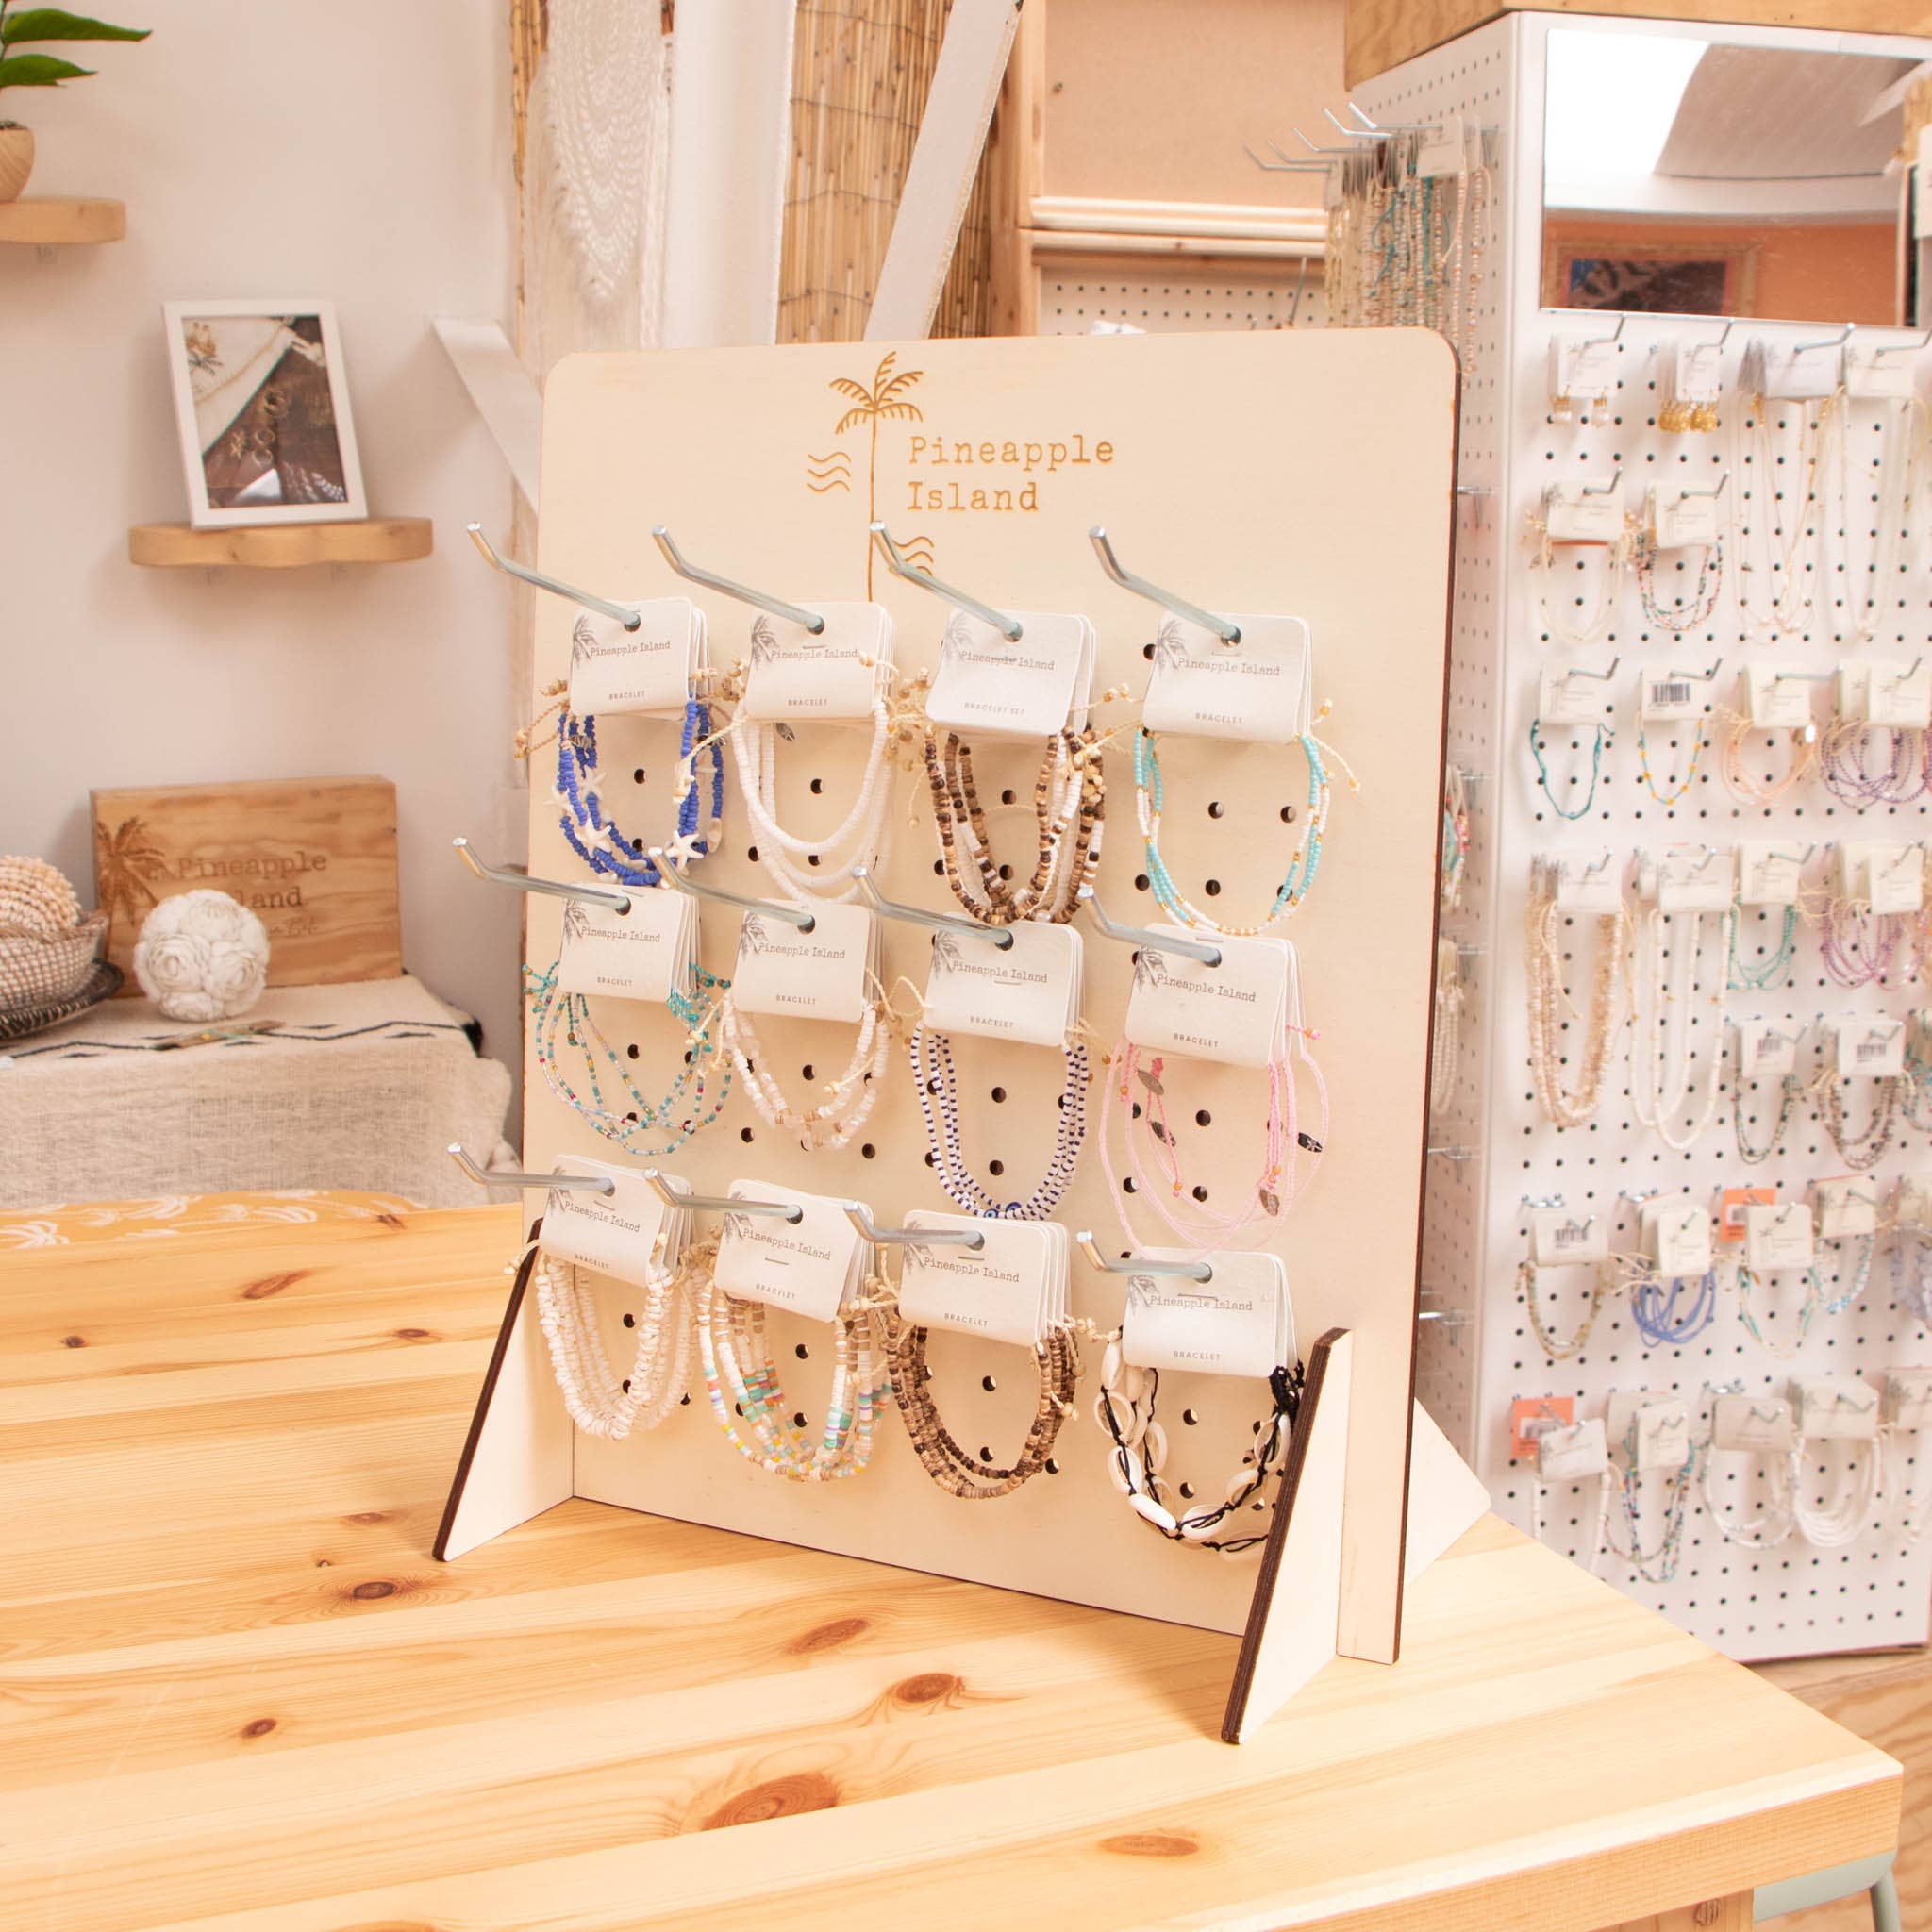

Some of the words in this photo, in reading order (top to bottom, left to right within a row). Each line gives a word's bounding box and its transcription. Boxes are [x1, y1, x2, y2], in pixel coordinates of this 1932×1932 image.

[909, 434, 1114, 471] Pineapple
[908, 482, 1039, 510] Island
[591, 643, 637, 657] Pineapple
[640, 641, 671, 652] Island
[770, 649, 822, 659] Pineapple
[824, 649, 858, 658] Island
[1018, 657, 1055, 671] Island
[1177, 658, 1238, 673] Pineapple
[1241, 664, 1281, 676] Island
[608, 691, 645, 700] BRACELET
[788, 698, 827, 707] BRACELET
[964, 703, 1008, 714] BRACELET
[1195, 713, 1243, 724] BRACELET
[177, 851, 327, 880] Pineapple
[234, 886, 303, 908] land
[581, 926, 628, 941] Pineapple
[629, 929, 660, 942] Island
[758, 942, 809, 957] Pineapple
[811, 948, 846, 959] Island
[952, 960, 1009, 979] Pineapple
[1010, 967, 1048, 983] Island
[597, 976, 633, 987] BRACELET
[1157, 974, 1214, 995] Pineapple
[1216, 986, 1257, 1003] Island
[775, 994, 816, 1005] BRACELET
[970, 1016, 1014, 1028] BRACELET
[1174, 1033, 1219, 1048] BRACELET
[565, 1201, 609, 1223] Pineapple
[610, 1214, 640, 1232] Island
[743, 1228, 795, 1250] Pineapple
[797, 1242, 831, 1260] Island
[575, 1254, 609, 1269] BRACELET
[924, 1257, 980, 1277] Pineapple
[983, 1267, 1020, 1283] Island
[756, 1283, 796, 1300] BRACELET
[1150, 1295, 1211, 1310] Pineapple
[1213, 1298, 1253, 1311] Island
[944, 1313, 989, 1327] BRACELET
[1173, 1351, 1222, 1361] BRACELET
